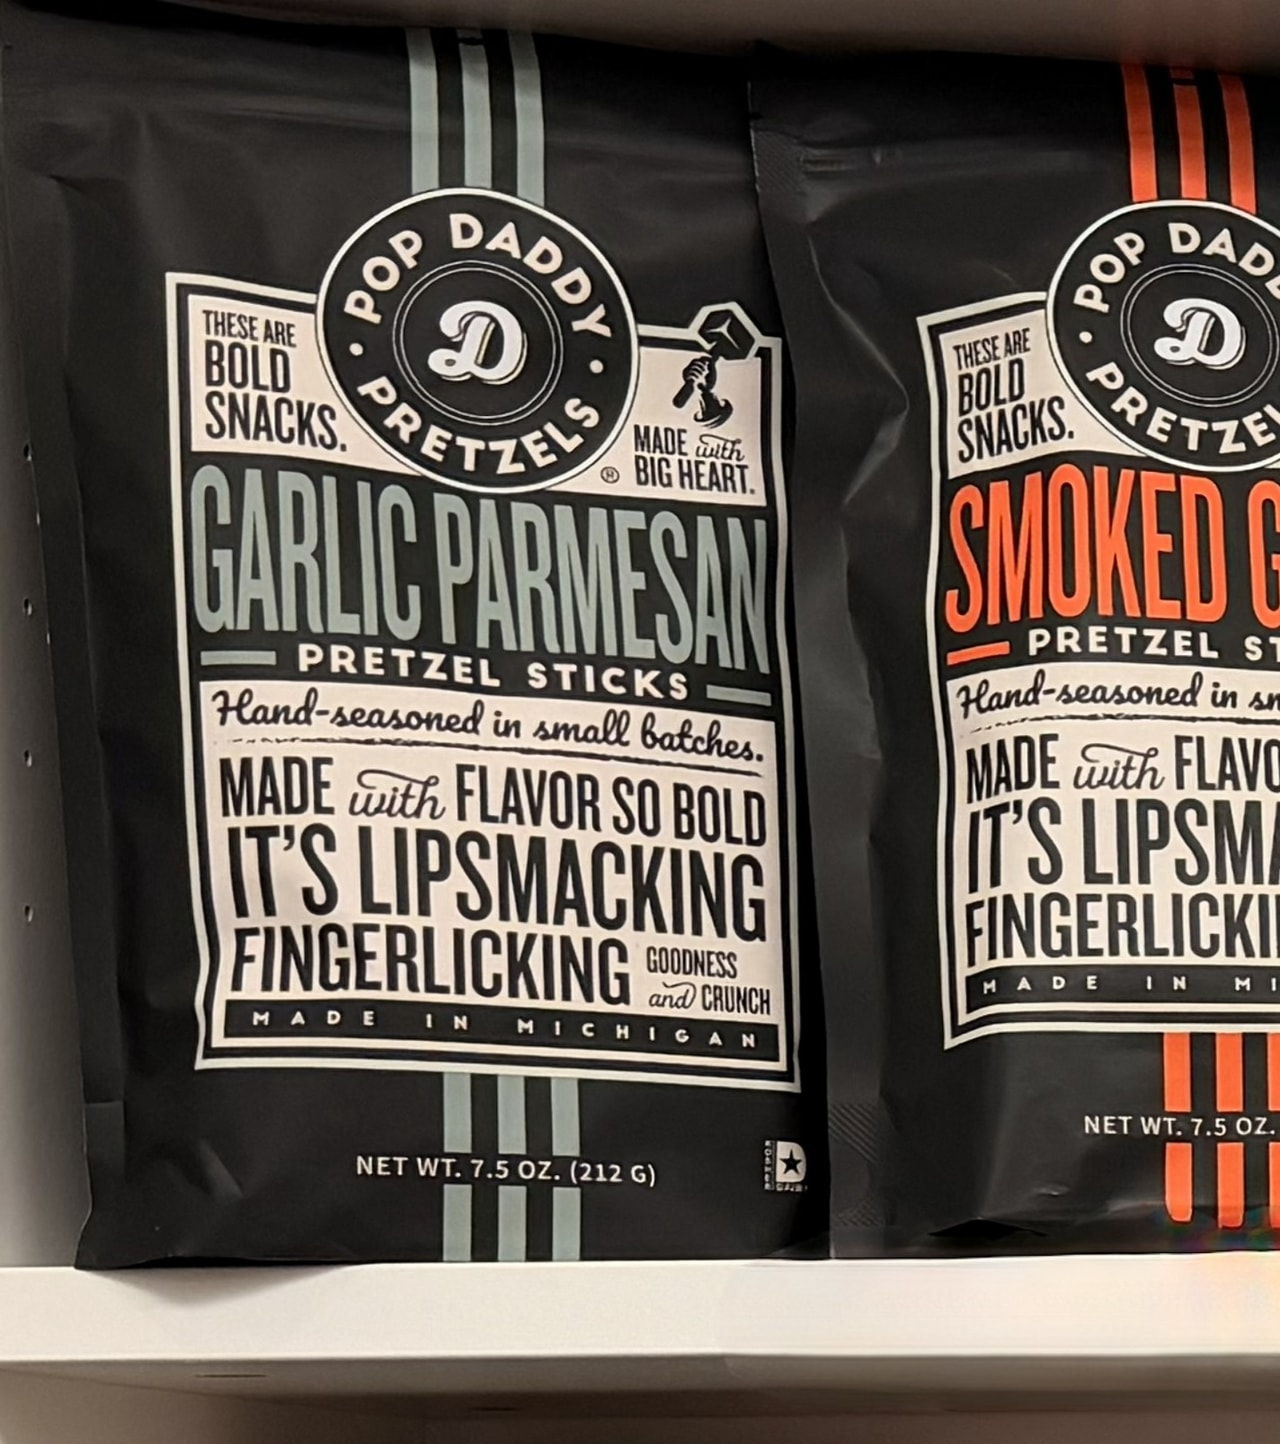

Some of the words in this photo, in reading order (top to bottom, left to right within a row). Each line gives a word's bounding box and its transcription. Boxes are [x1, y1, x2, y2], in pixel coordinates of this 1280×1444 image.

[345, 229, 425, 325] POP
[450, 212, 613, 339] DADDY
[1073, 231, 1146, 313] POP
[203, 310, 256, 343] THESE
[263, 319, 296, 347] ARE
[205, 340, 291, 394] BOLD
[205, 395, 347, 452] SNACKS.
[358, 375, 600, 475] PRETZELS
[192, 465, 422, 640] GARLIC
[433, 492, 767, 674] PARMESAN
[946, 464, 1227, 633] SMOKED
[298, 644, 500, 687] PRETZEL
[528, 663, 689, 701] STICKS
[1028, 626, 1219, 658] PRETZEL
[212, 688, 483, 736] Hand-seasoned
[494, 710, 521, 739] in
[533, 709, 631, 748] small
[640, 717, 766, 762] batches.
[966, 733, 1060, 804] MADE
[1073, 743, 1165, 791] with
[357, 1156, 408, 1178] NET
[416, 1158, 462, 1178] WT.
[470, 1159, 509, 1179] 7.5
[518, 1160, 561, 1181] OZ.
[570, 1160, 623, 1185] (212
[632, 1163, 656, 1186] G)
